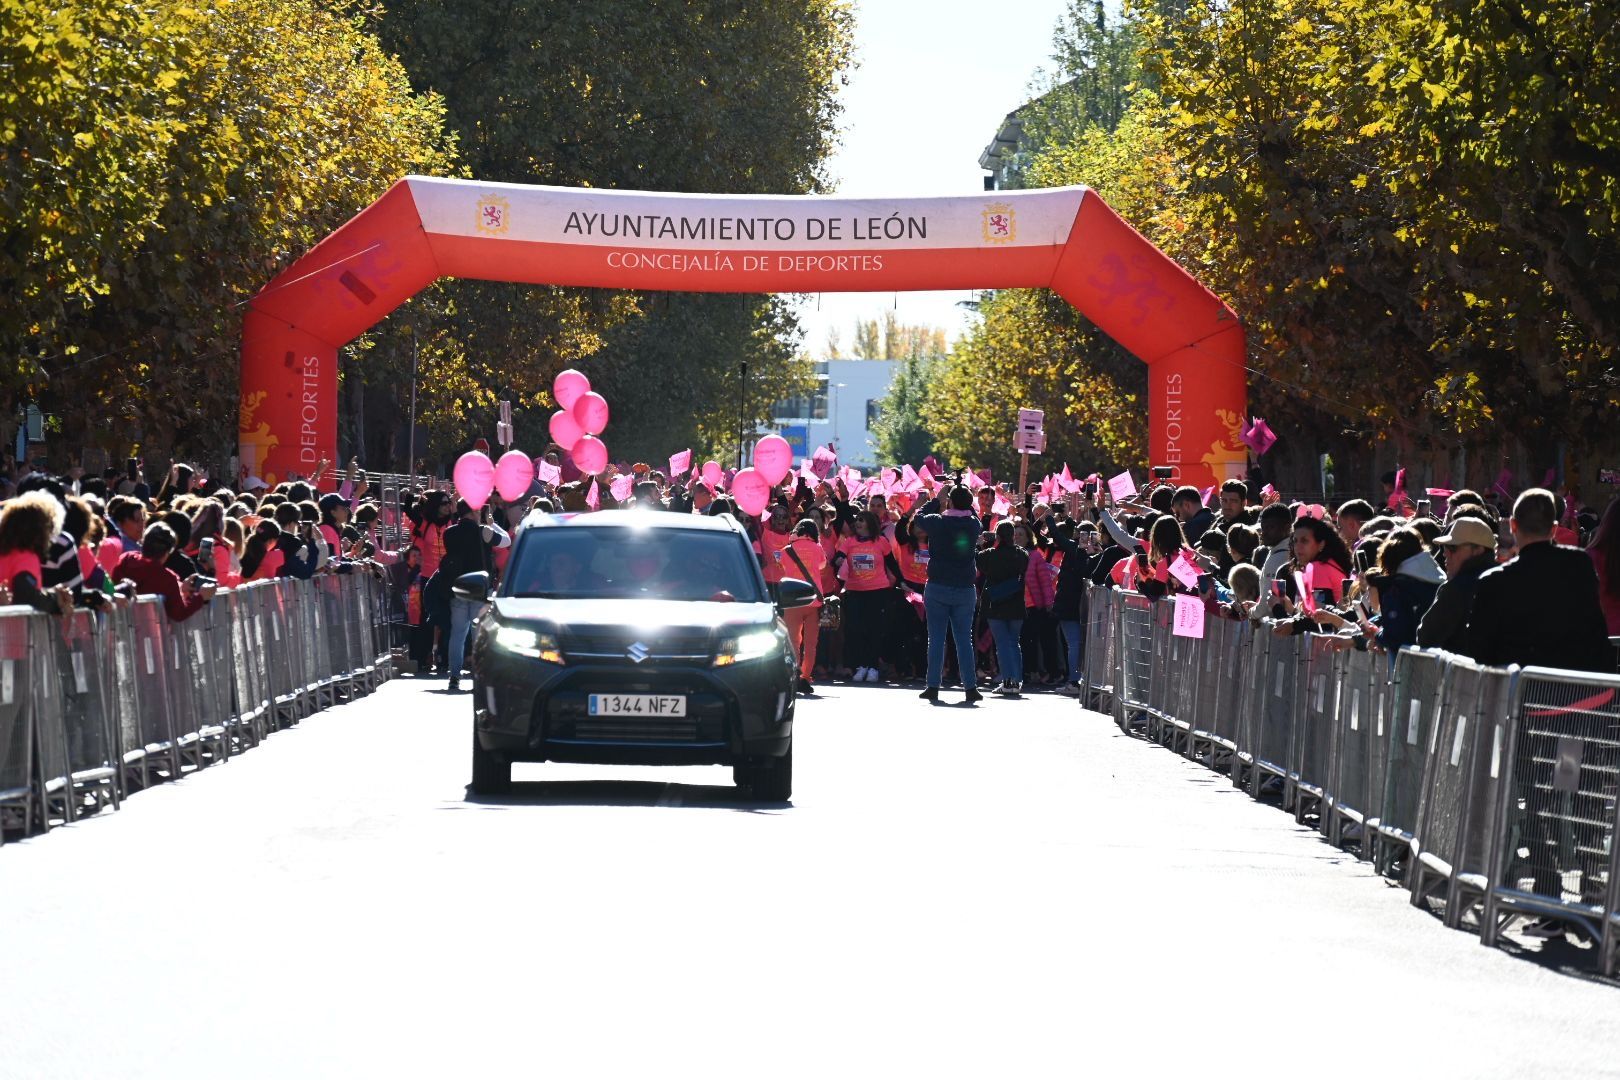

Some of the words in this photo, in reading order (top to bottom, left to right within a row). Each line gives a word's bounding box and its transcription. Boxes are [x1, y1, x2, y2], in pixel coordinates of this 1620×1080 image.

[563, 211, 795, 240] AYUNTAMIENTO
[806, 218, 842, 240] DE
[853, 211, 927, 240] LEÓN
[606, 251, 734, 272] CONCEJALÍA
[743, 256, 769, 271] DE
[778, 255, 883, 271] DEPORTES
[300, 356, 319, 463] DEPORTES
[602, 697, 642, 713] 1344
[648, 697, 680, 713] NFZ
